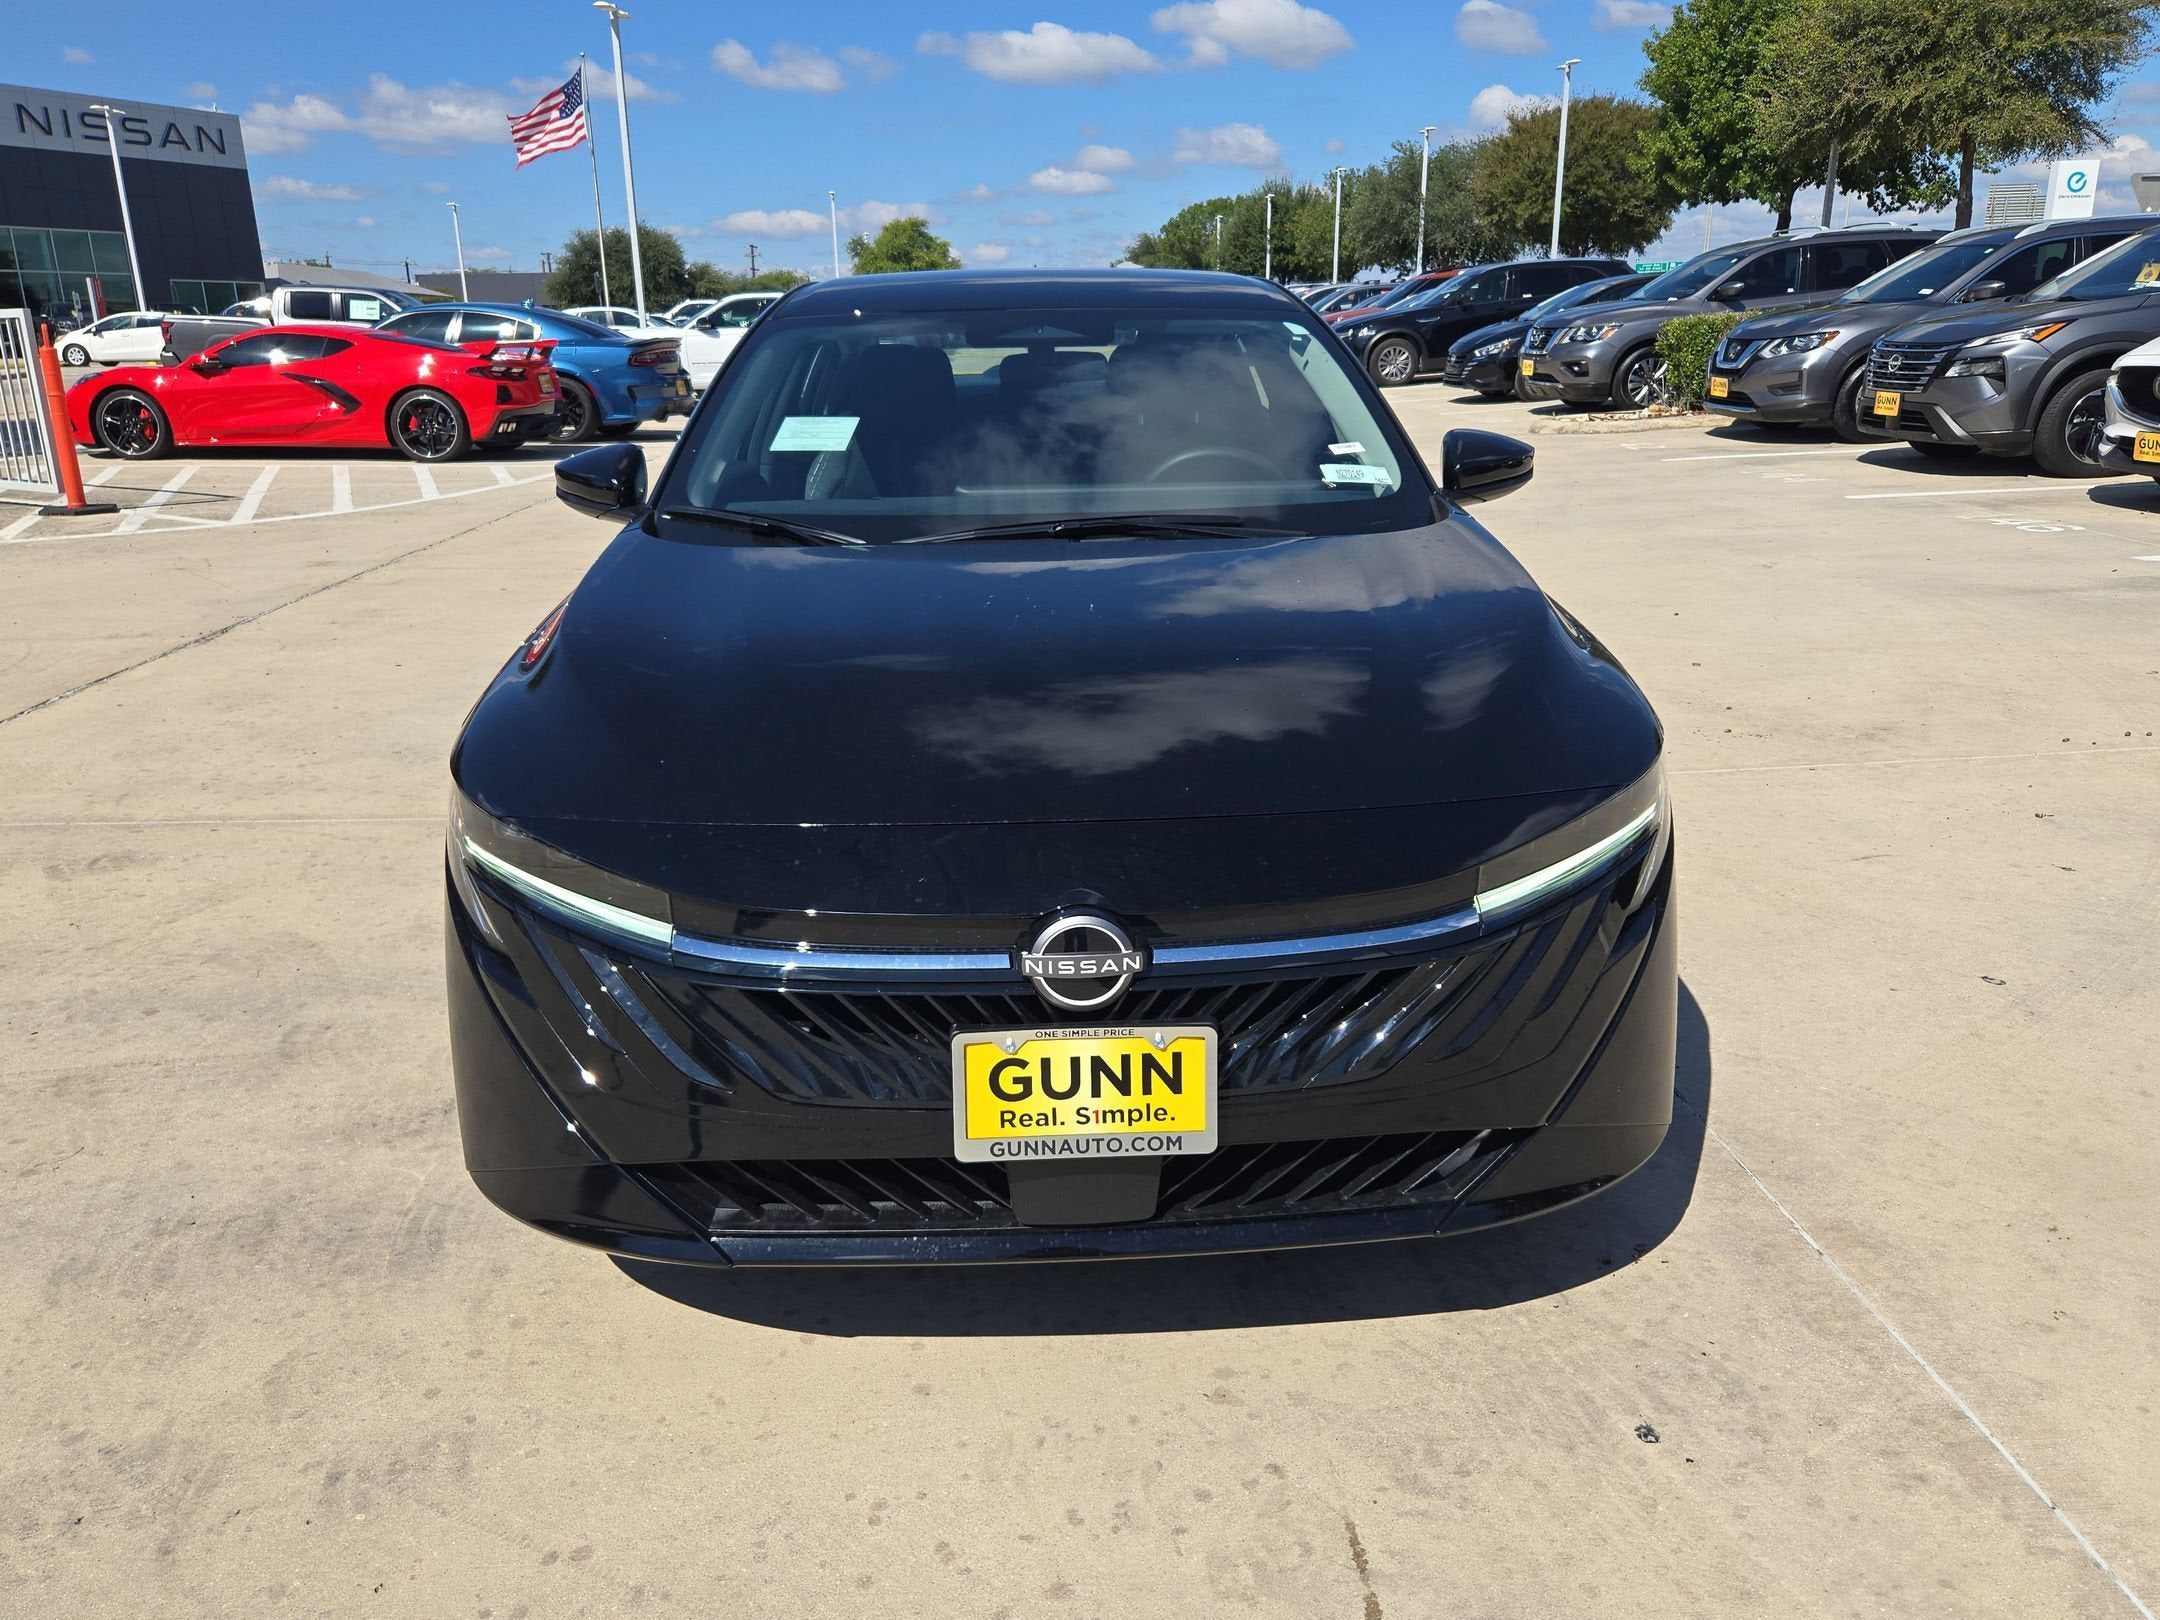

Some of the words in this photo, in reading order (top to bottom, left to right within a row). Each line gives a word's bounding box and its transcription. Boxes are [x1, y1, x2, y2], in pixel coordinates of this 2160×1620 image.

[16, 103, 226, 155] NISSAN
[1877, 395, 1898, 406] GUNN
[2139, 438, 2160, 450] GUN
[1024, 955, 1141, 975] NISSAN
[1062, 1030, 1100, 1038] SIMPLE
[1103, 1028, 1135, 1037] PRICE
[988, 1051, 1183, 1103] GUNN
[1000, 1107, 1065, 1129] Real.
[989, 1135, 1183, 1158] GUNNAUTO.COM
